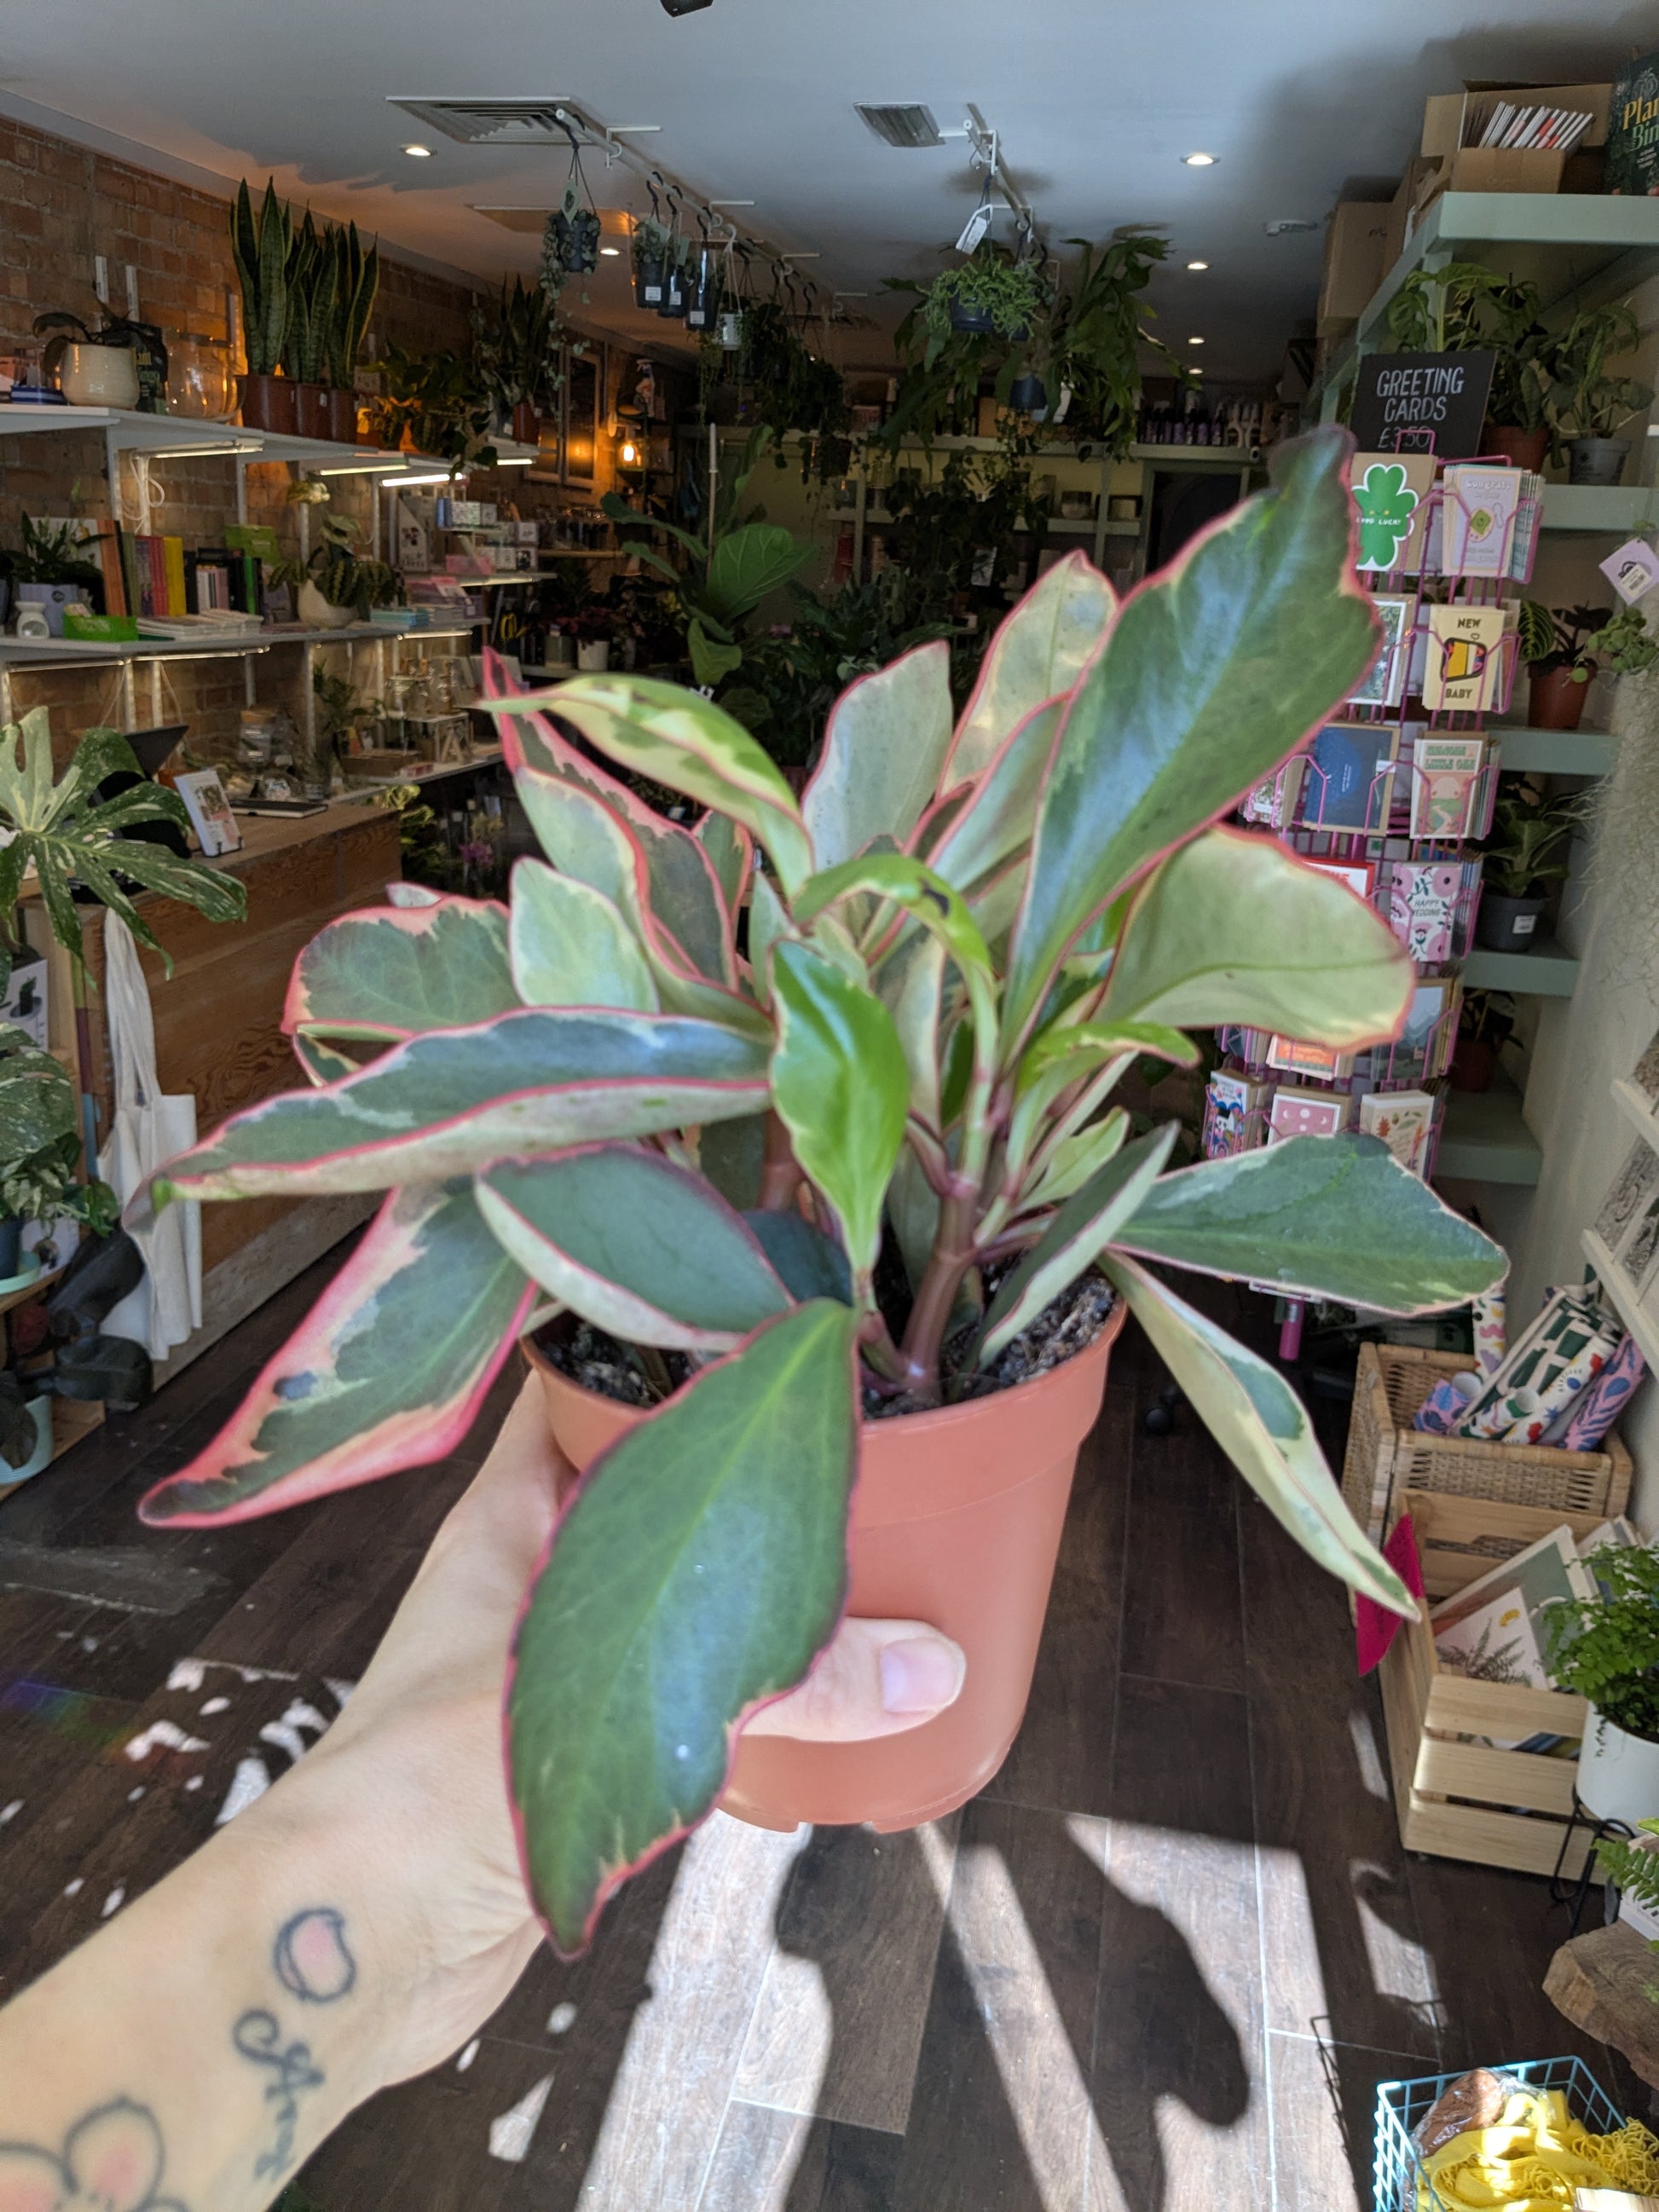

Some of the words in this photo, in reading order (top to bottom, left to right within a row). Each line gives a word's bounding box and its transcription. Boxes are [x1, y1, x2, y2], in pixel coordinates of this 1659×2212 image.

[1376, 367, 1465, 397] GREETING
[1384, 396, 1447, 423] CARDS
[1457, 618, 1482, 628] NEW
[1445, 688, 1472, 698] BABY
[1414, 898, 1440, 907] HAPPY
